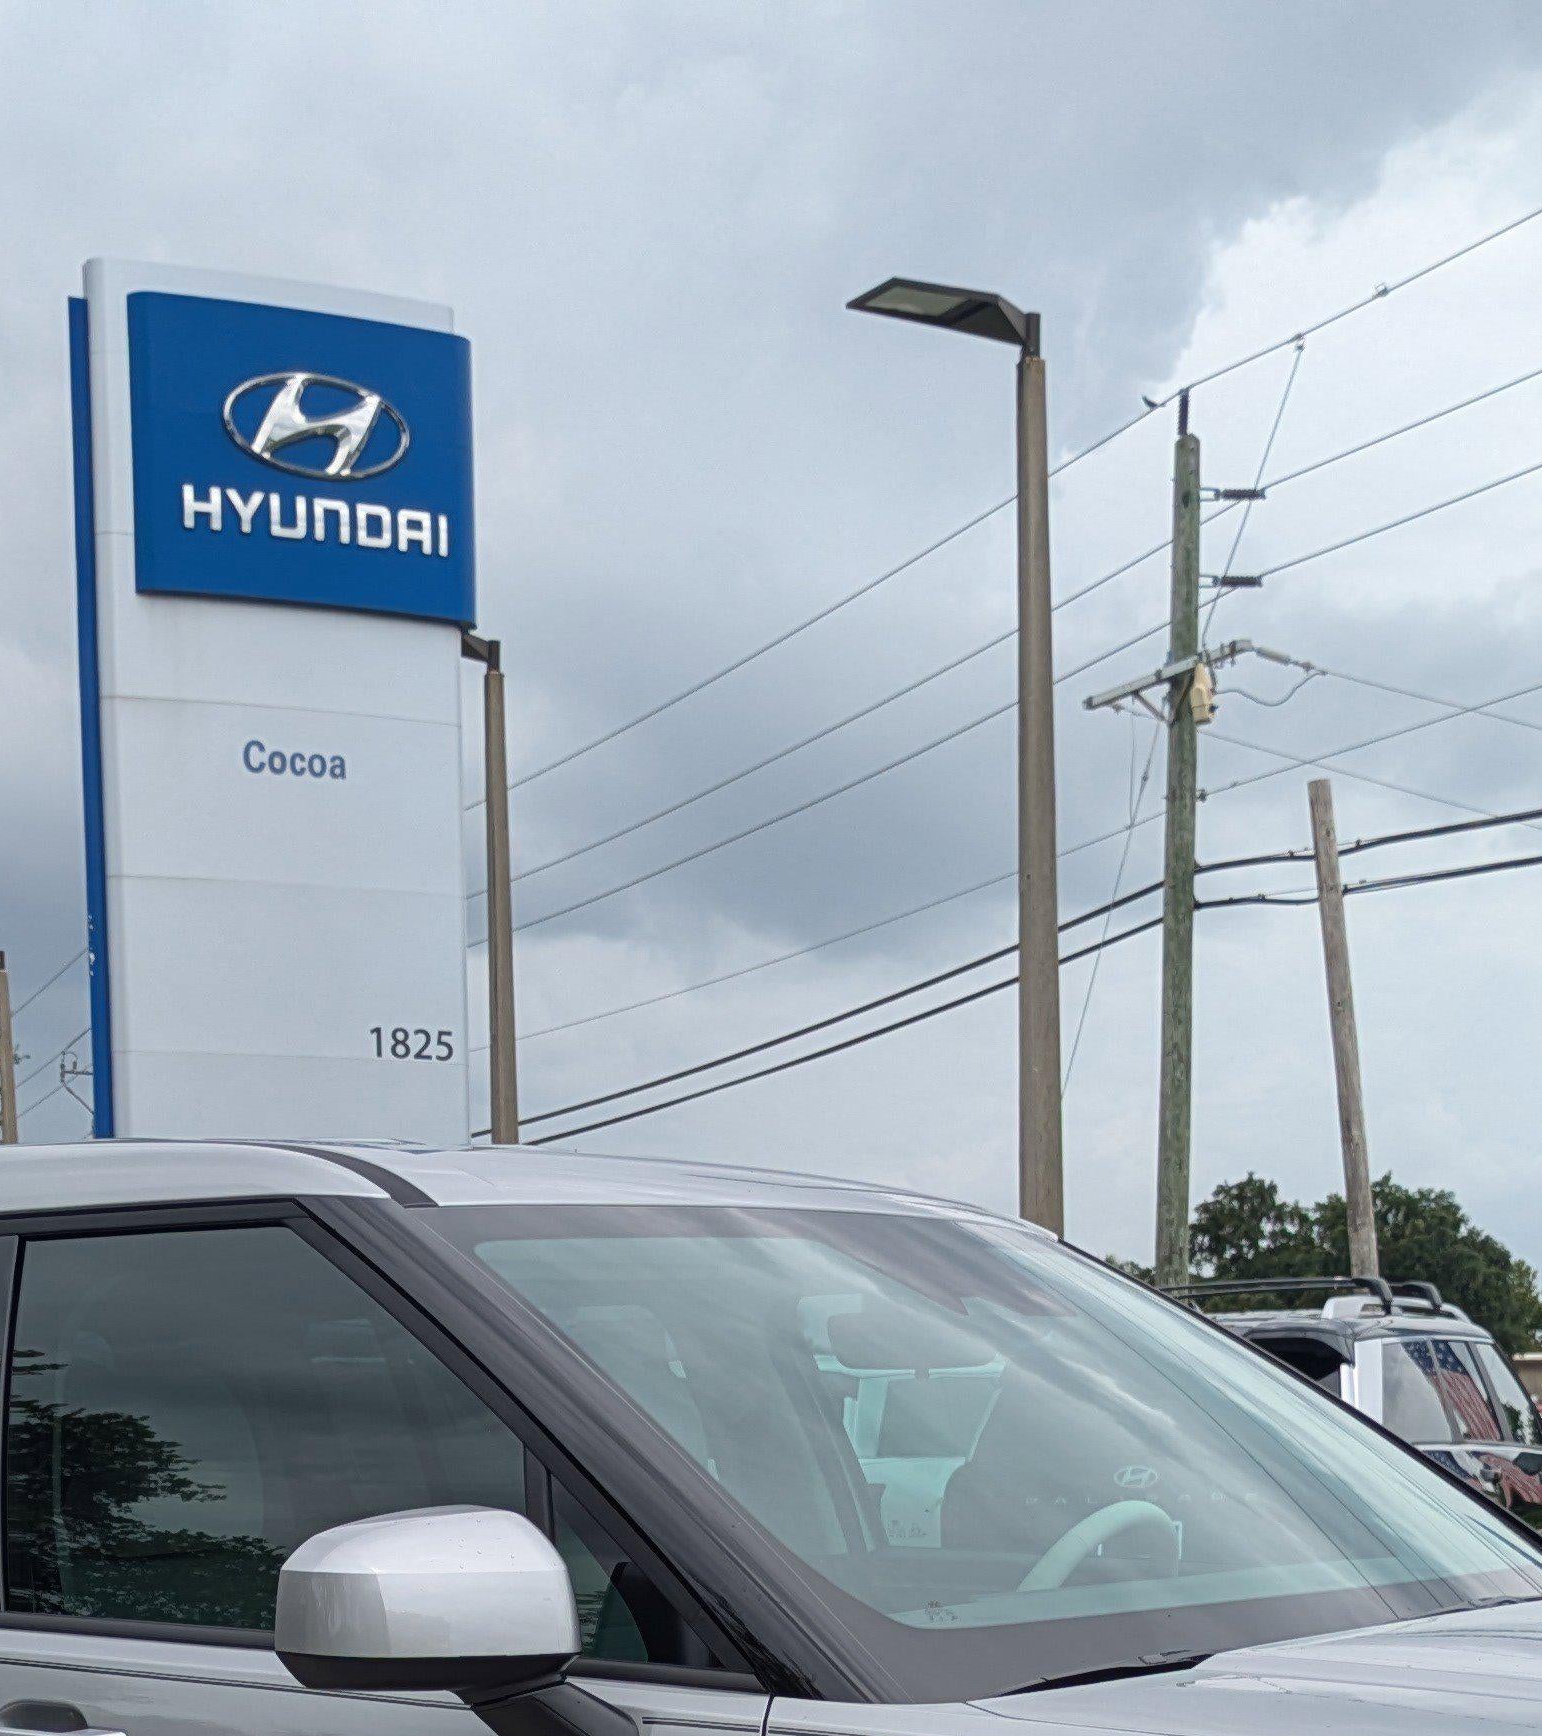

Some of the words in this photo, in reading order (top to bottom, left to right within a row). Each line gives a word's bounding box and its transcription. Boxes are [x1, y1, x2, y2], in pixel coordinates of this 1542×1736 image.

[182, 484, 449, 557] HYUNDAI
[243, 740, 347, 779] Cocoa
[370, 1027, 454, 1062] 1825
